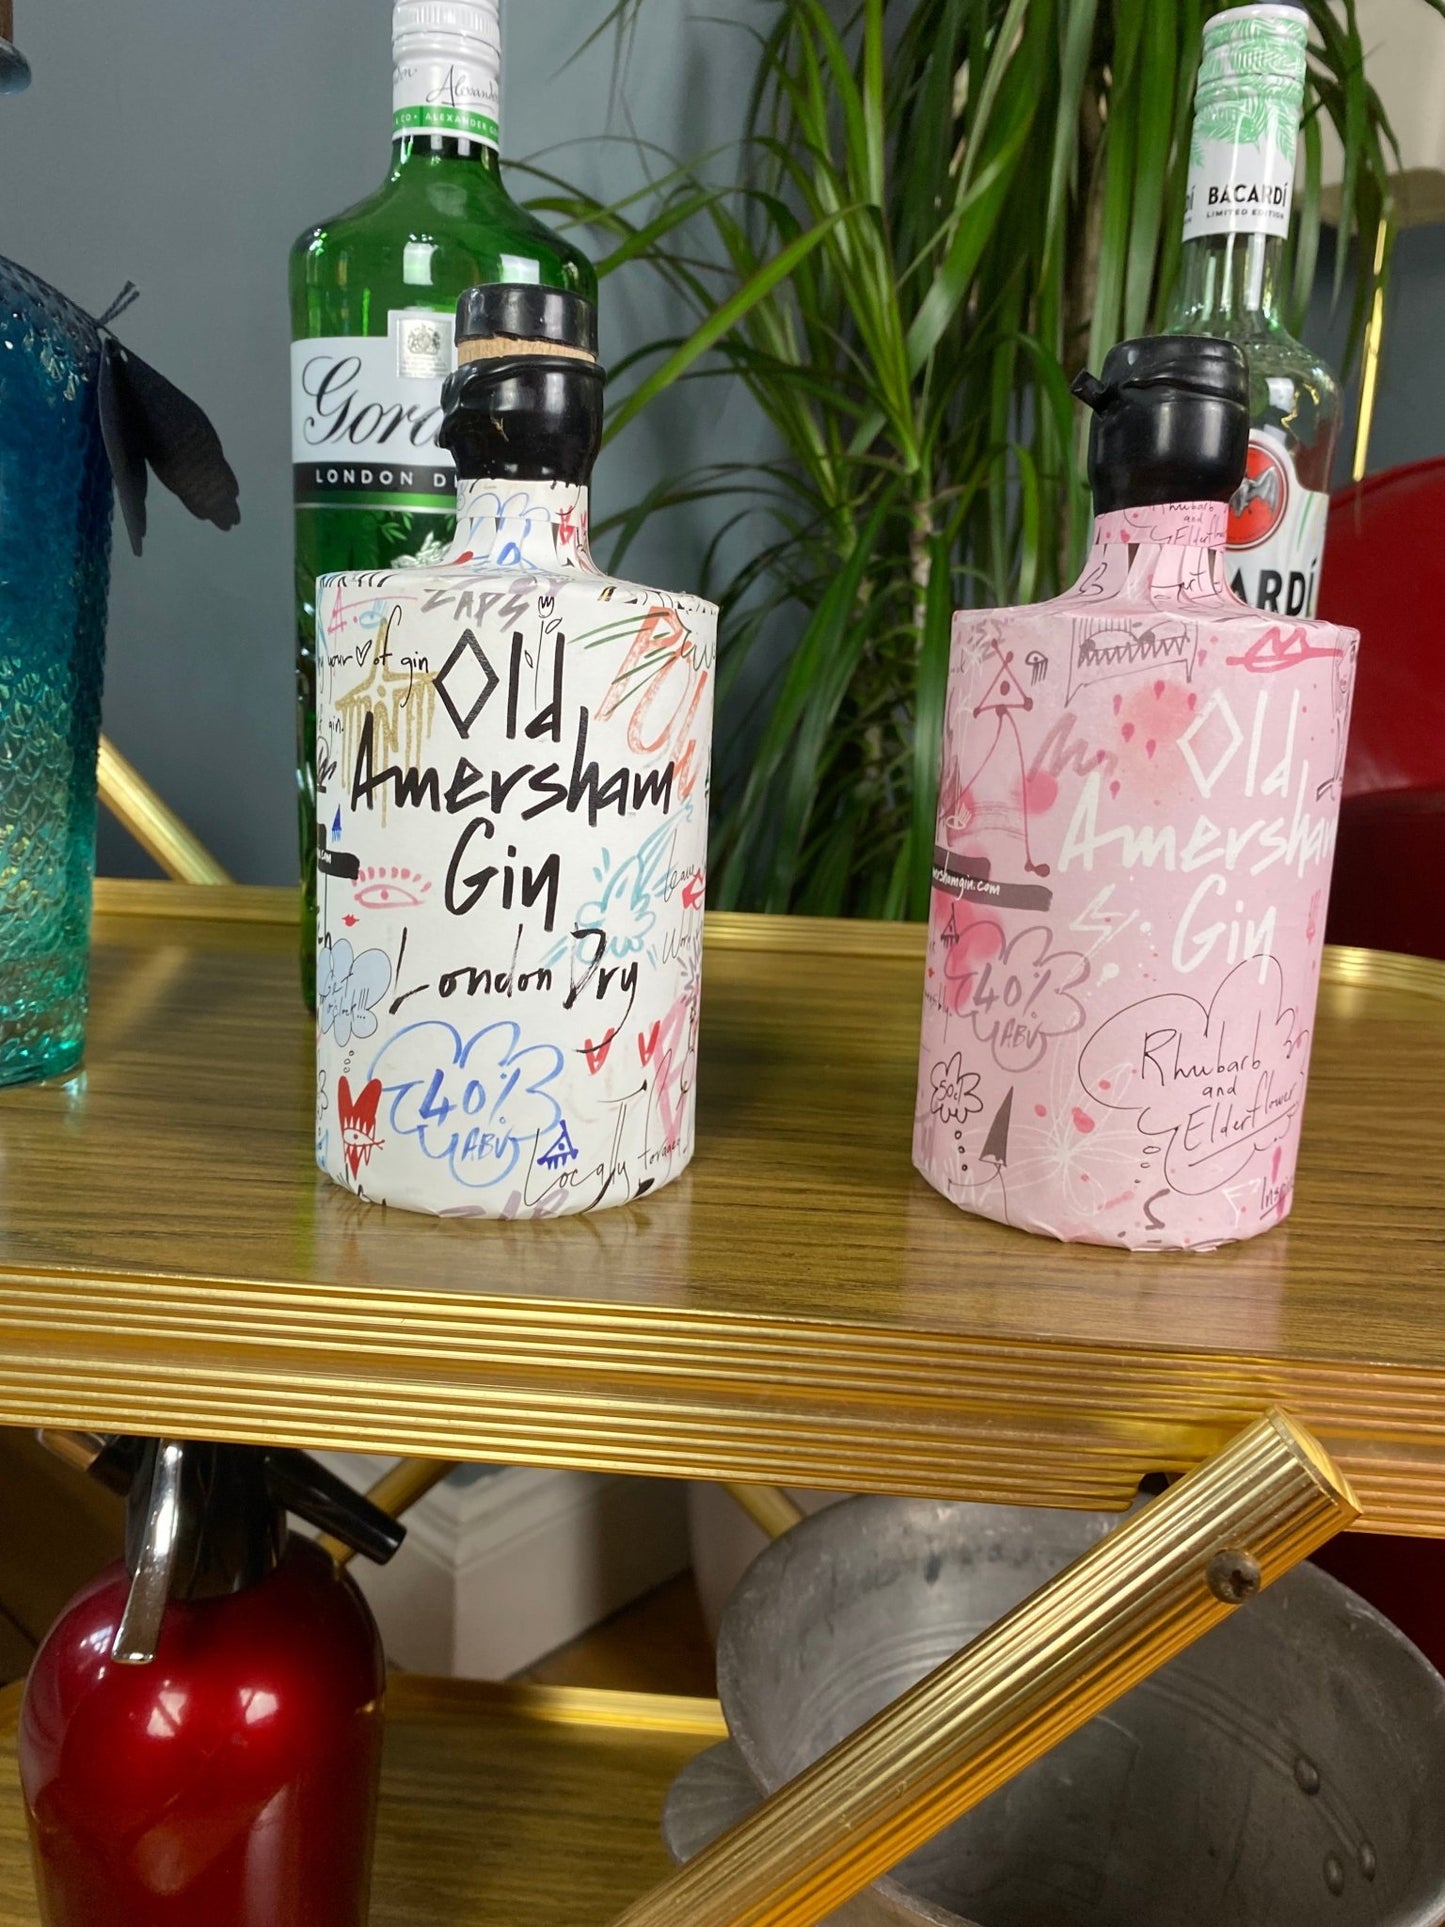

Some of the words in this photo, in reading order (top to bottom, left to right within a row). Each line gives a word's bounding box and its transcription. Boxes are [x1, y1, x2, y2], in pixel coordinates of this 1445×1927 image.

[425, 111, 487, 131] ALEXANDER
[1206, 208, 1248, 219] LIMITED
[1208, 182, 1288, 208] BACARDÍ
[316, 469, 413, 486] LONDON
[433, 473, 458, 488] D
[1230, 556, 1318, 617] ARDÍ
[400, 650, 430, 708] gin
[432, 628, 566, 743] Old
[351, 705, 675, 828] Amersham
[1176, 689, 1300, 799] Old
[444, 817, 560, 932] Gin
[1171, 873, 1277, 985] Gin
[388, 923, 552, 1015] London
[563, 921, 638, 1053] Dry
[972, 962, 1052, 1015] 40%
[1000, 1018, 1043, 1050] ABV
[1141, 1009, 1261, 1087] Rhubarb
[418, 1068, 521, 1125] 40%
[1183, 1069, 1297, 1152] Elderflower
[1202, 1075, 1238, 1099] and
[461, 1127, 512, 1161] ABV
